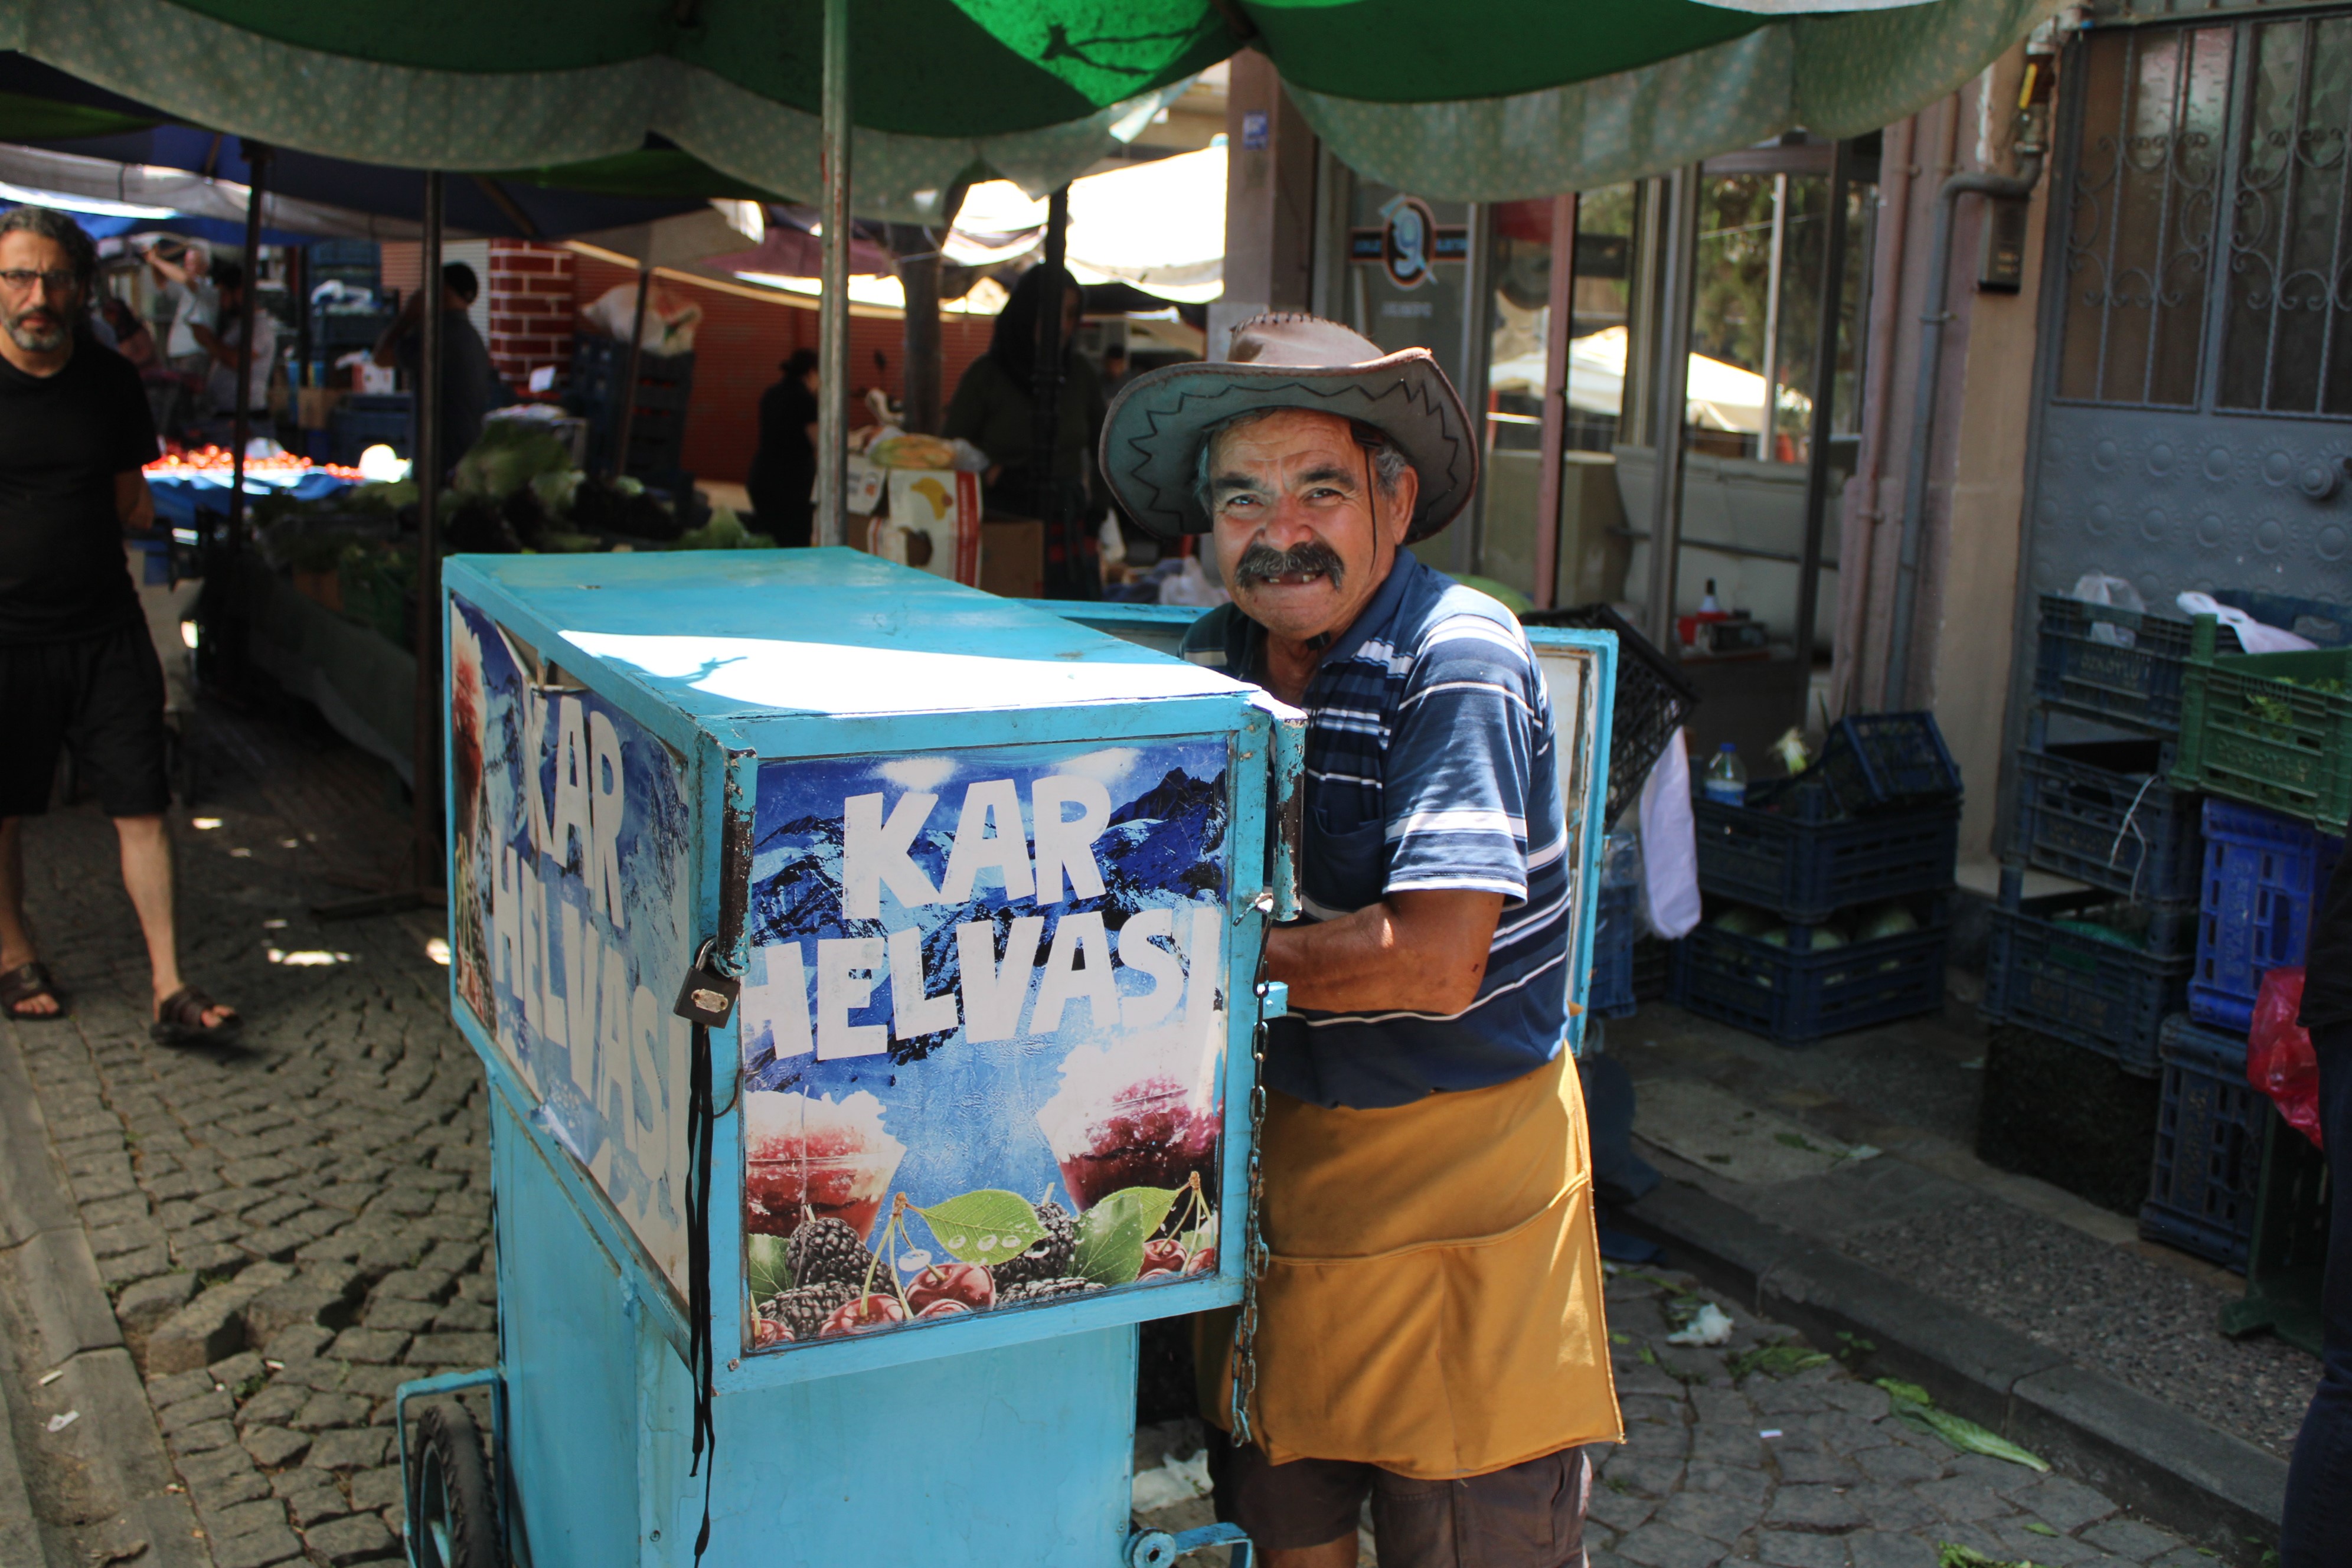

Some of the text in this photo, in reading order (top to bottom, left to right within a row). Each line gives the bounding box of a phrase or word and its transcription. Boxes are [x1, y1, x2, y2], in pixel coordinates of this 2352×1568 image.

[522, 682, 625, 929] KAR
[842, 776, 1111, 920] KAR
[491, 823, 687, 1207] HELVASI
[741, 907, 1222, 1061] HELVASI
